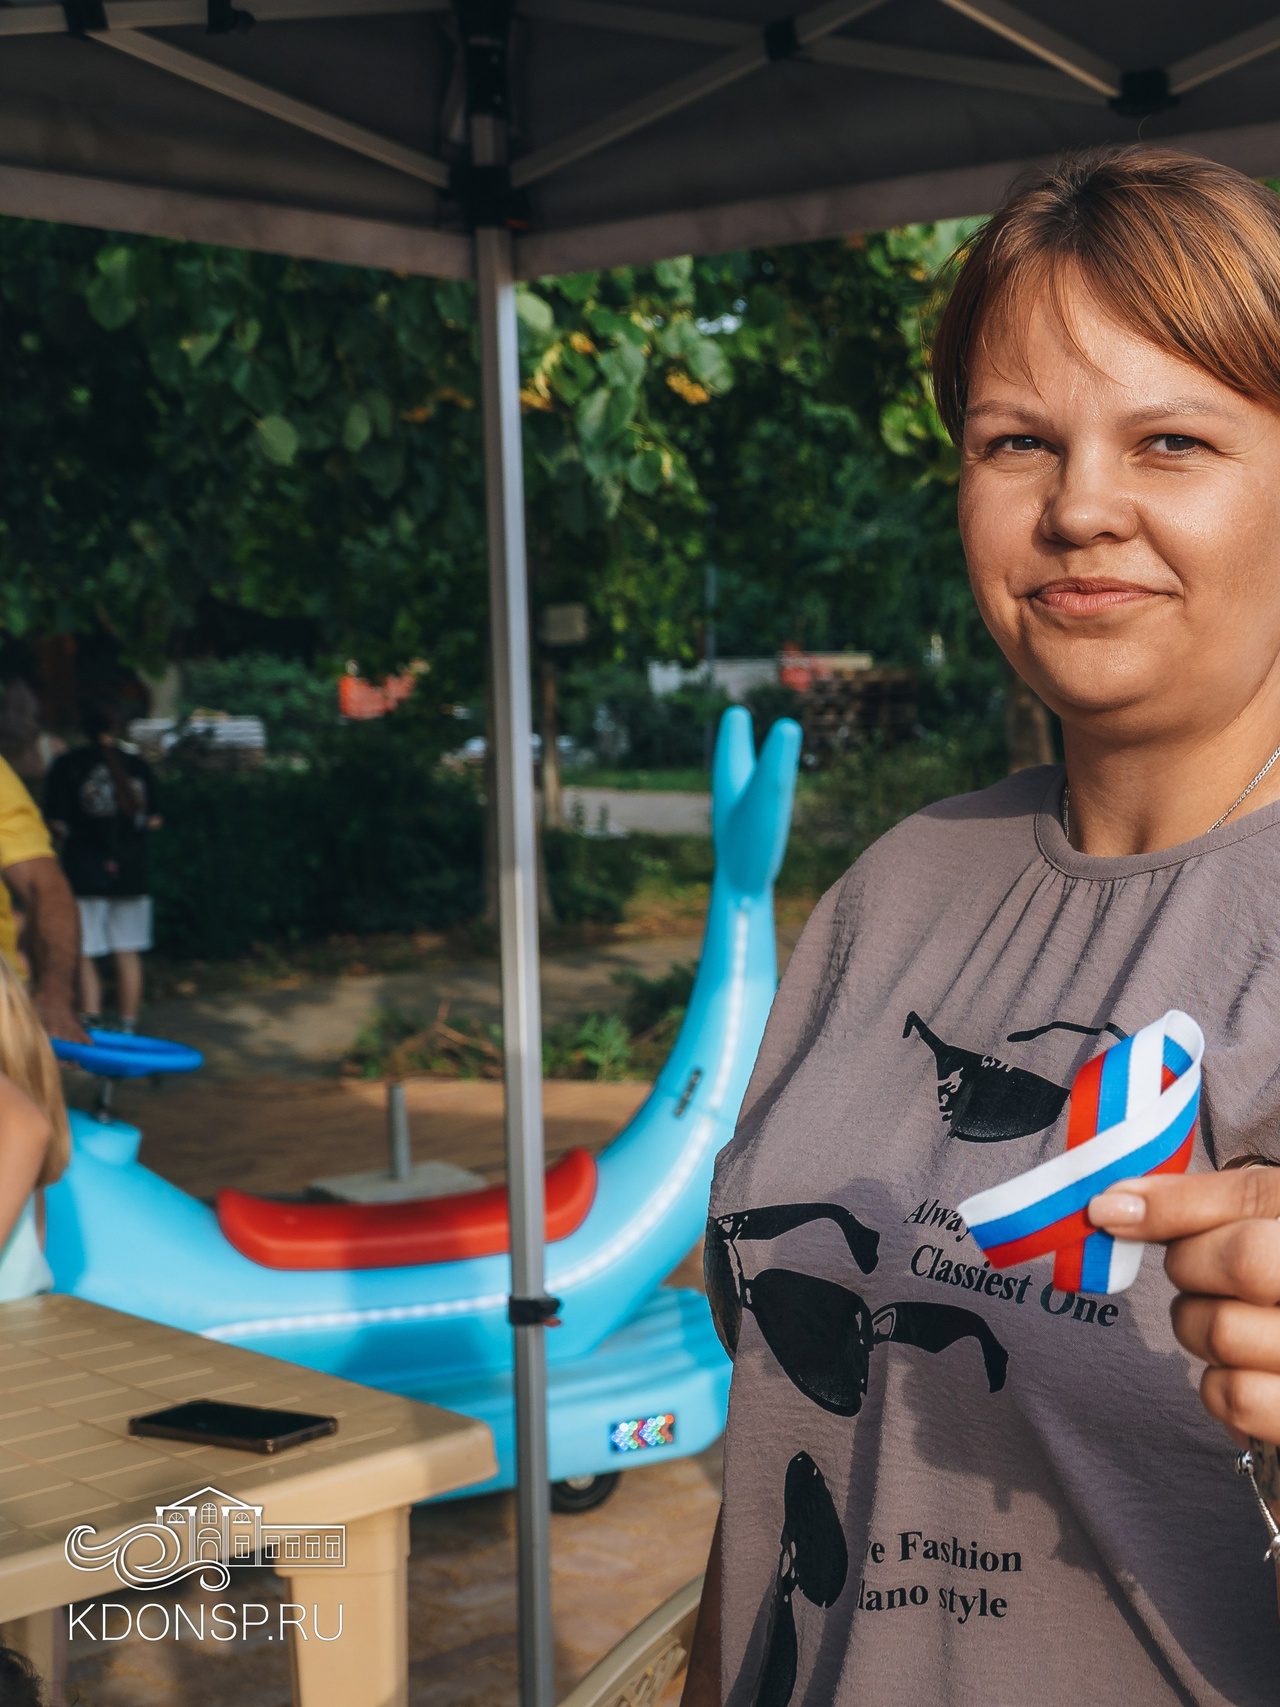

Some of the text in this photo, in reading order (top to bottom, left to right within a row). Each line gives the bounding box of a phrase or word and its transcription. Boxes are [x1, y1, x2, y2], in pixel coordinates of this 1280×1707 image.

[910, 1244, 1119, 1327] Classiest One
[865, 1531, 1022, 1573] e Fashion
[856, 1577, 1008, 1625] lano style
